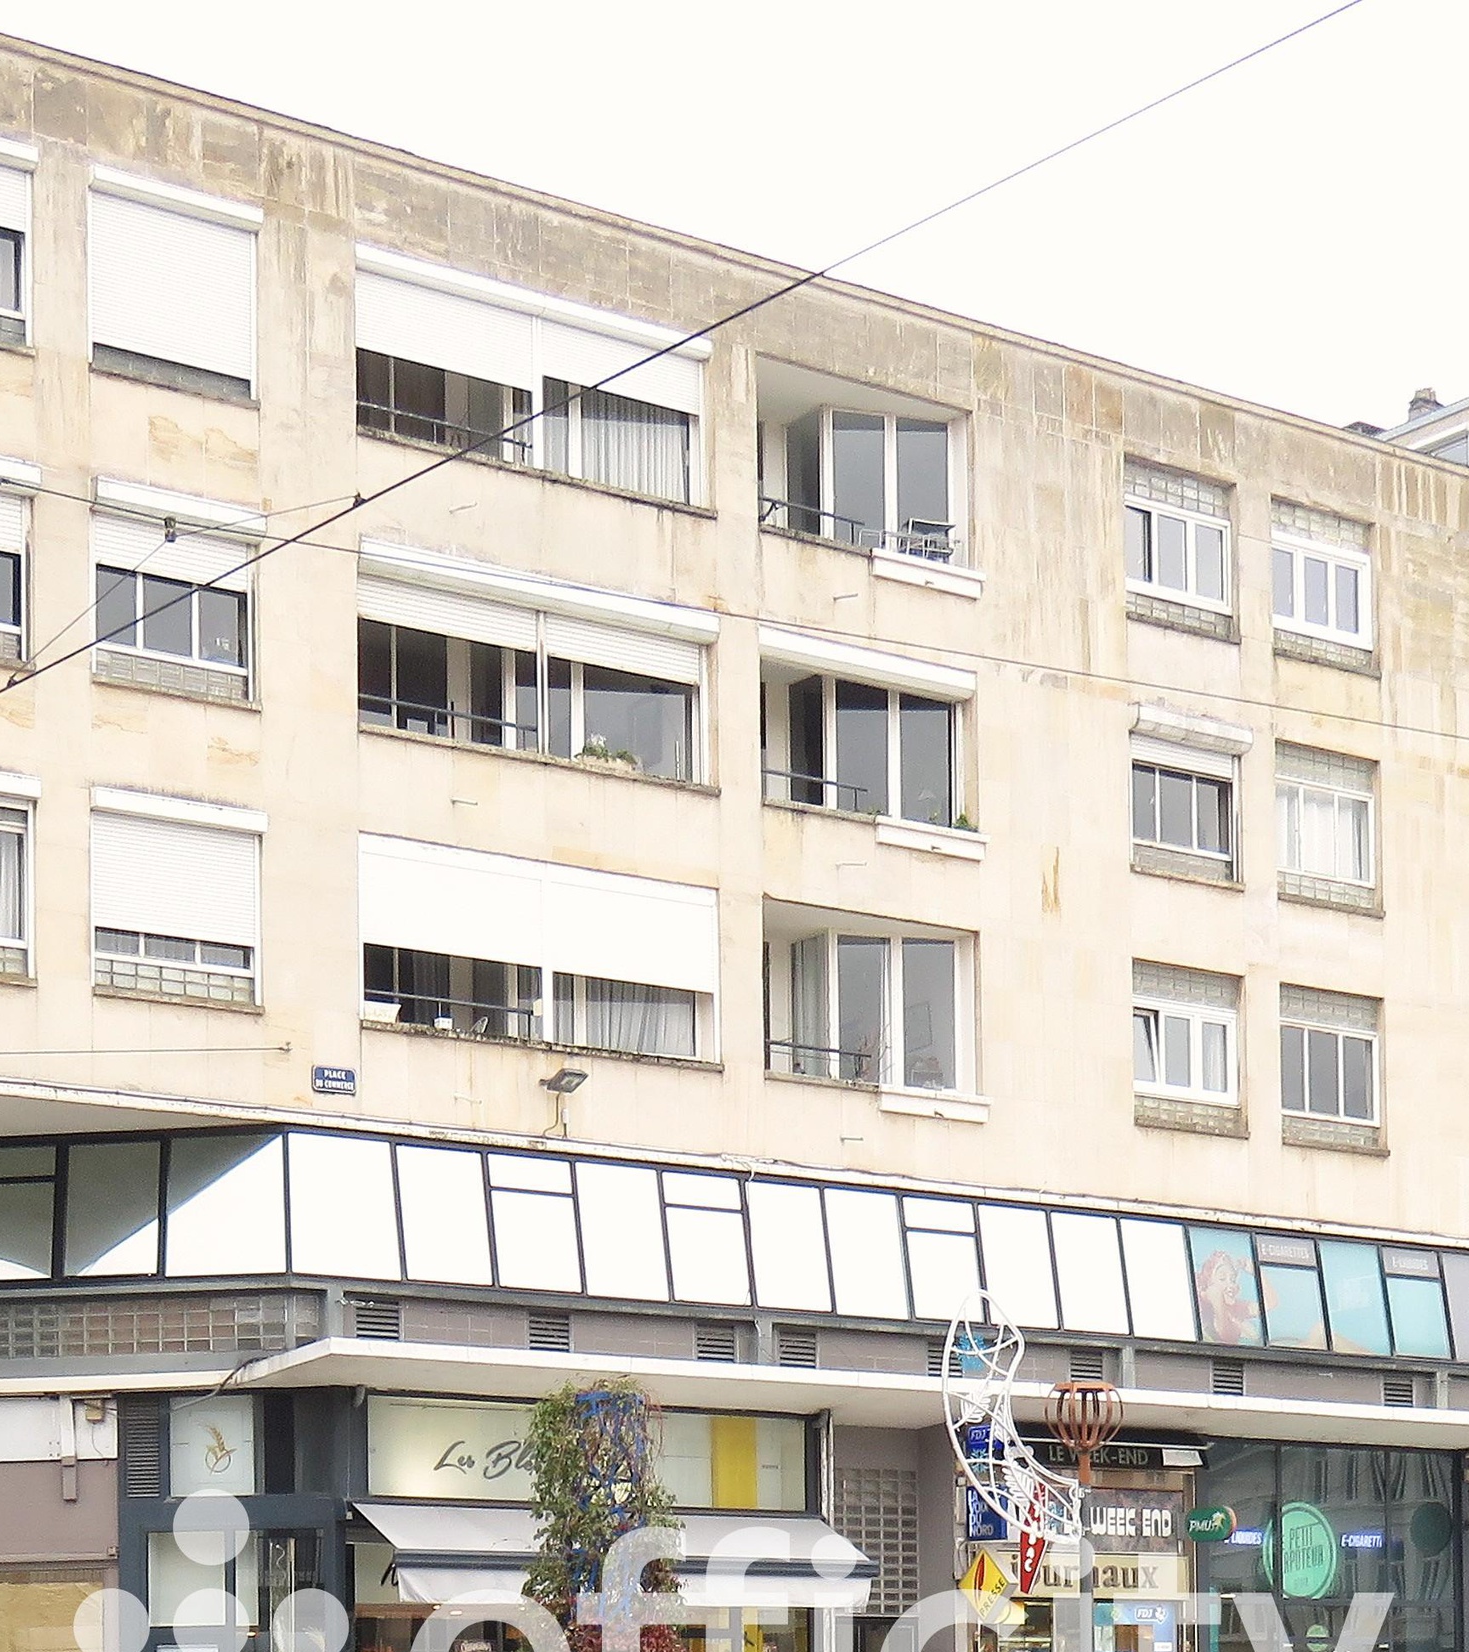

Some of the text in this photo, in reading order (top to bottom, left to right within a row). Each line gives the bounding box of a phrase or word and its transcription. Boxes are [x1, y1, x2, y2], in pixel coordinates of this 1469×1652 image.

[1066, 1446, 1150, 1465] WEK-END
[1090, 1506, 1137, 1537] WEEK
[1142, 1509, 1172, 1538] END
[1189, 1519, 1213, 1532] PMU
[1283, 1545, 1324, 1574] APOTEUR
[980, 1577, 1006, 1617] PRESSE
[1137, 1608, 1153, 1618] FDJ
